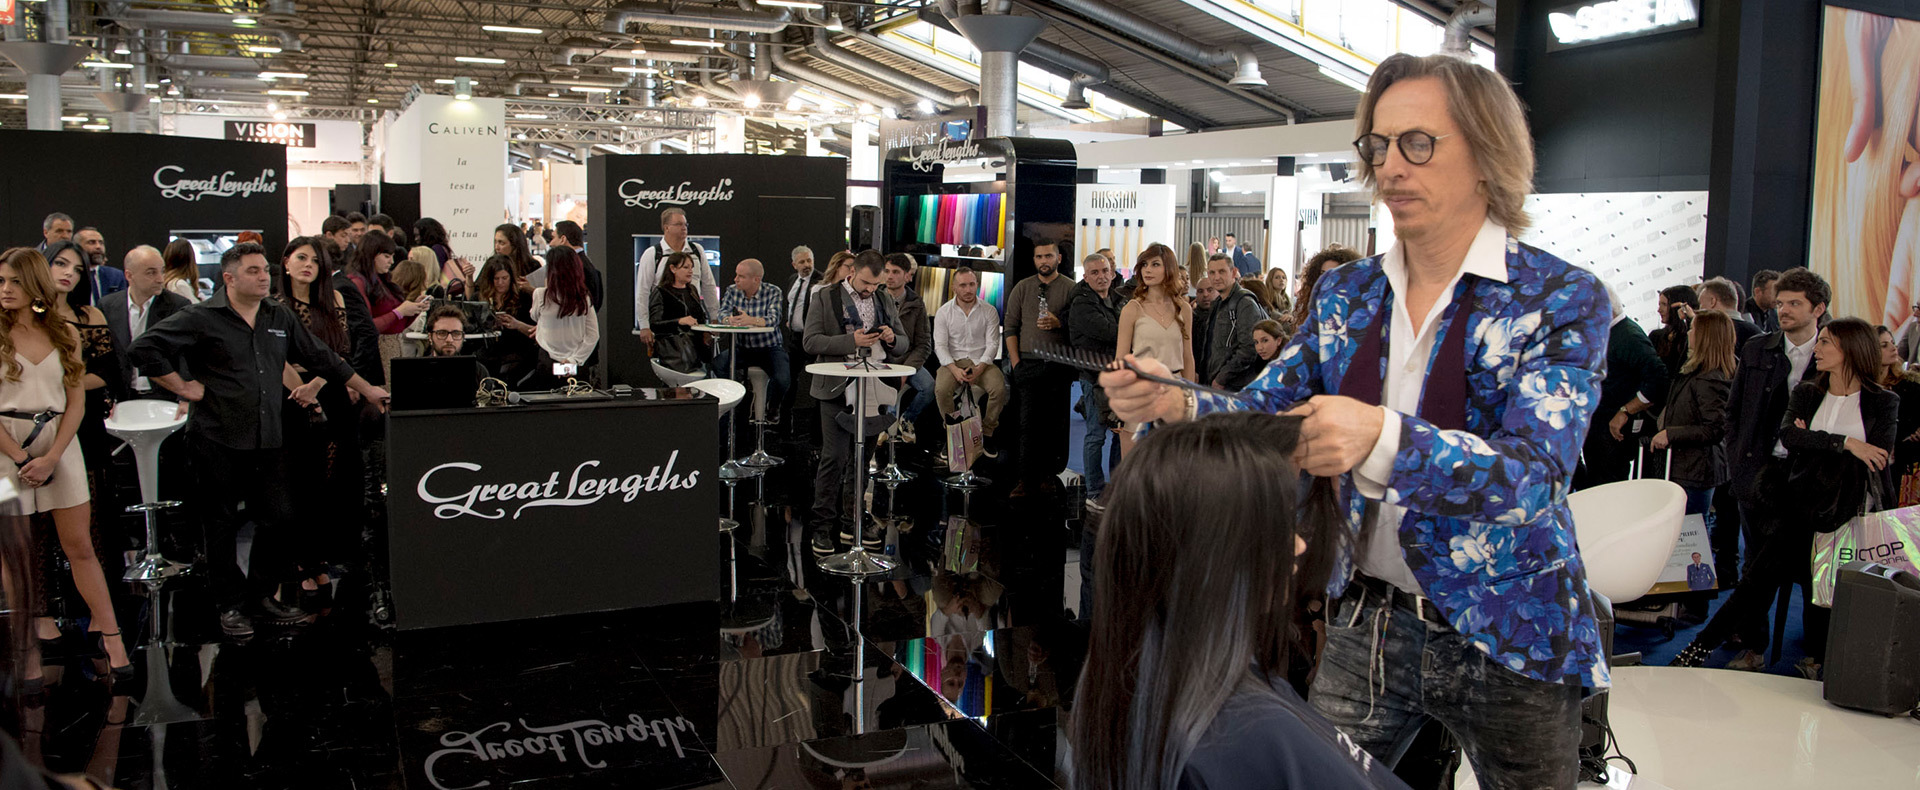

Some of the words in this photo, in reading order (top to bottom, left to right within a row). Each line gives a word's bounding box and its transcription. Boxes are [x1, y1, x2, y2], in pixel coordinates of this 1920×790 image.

[234, 122, 304, 138] VISION
[428, 122, 497, 136] CALIVEN
[909, 136, 946, 172] Great
[929, 128, 980, 172] Lengths
[457, 157, 467, 166] la
[153, 165, 218, 201] Great
[196, 168, 277, 201] Lengths
[449, 182, 475, 190] testa
[618, 178, 675, 209] Great
[654, 178, 734, 209] Lengths
[1091, 190, 1137, 209] RUSSIAN
[453, 207, 469, 216] per
[461, 230, 478, 238] tua
[417, 462, 560, 520] Great
[513, 449, 700, 520] Lengths
